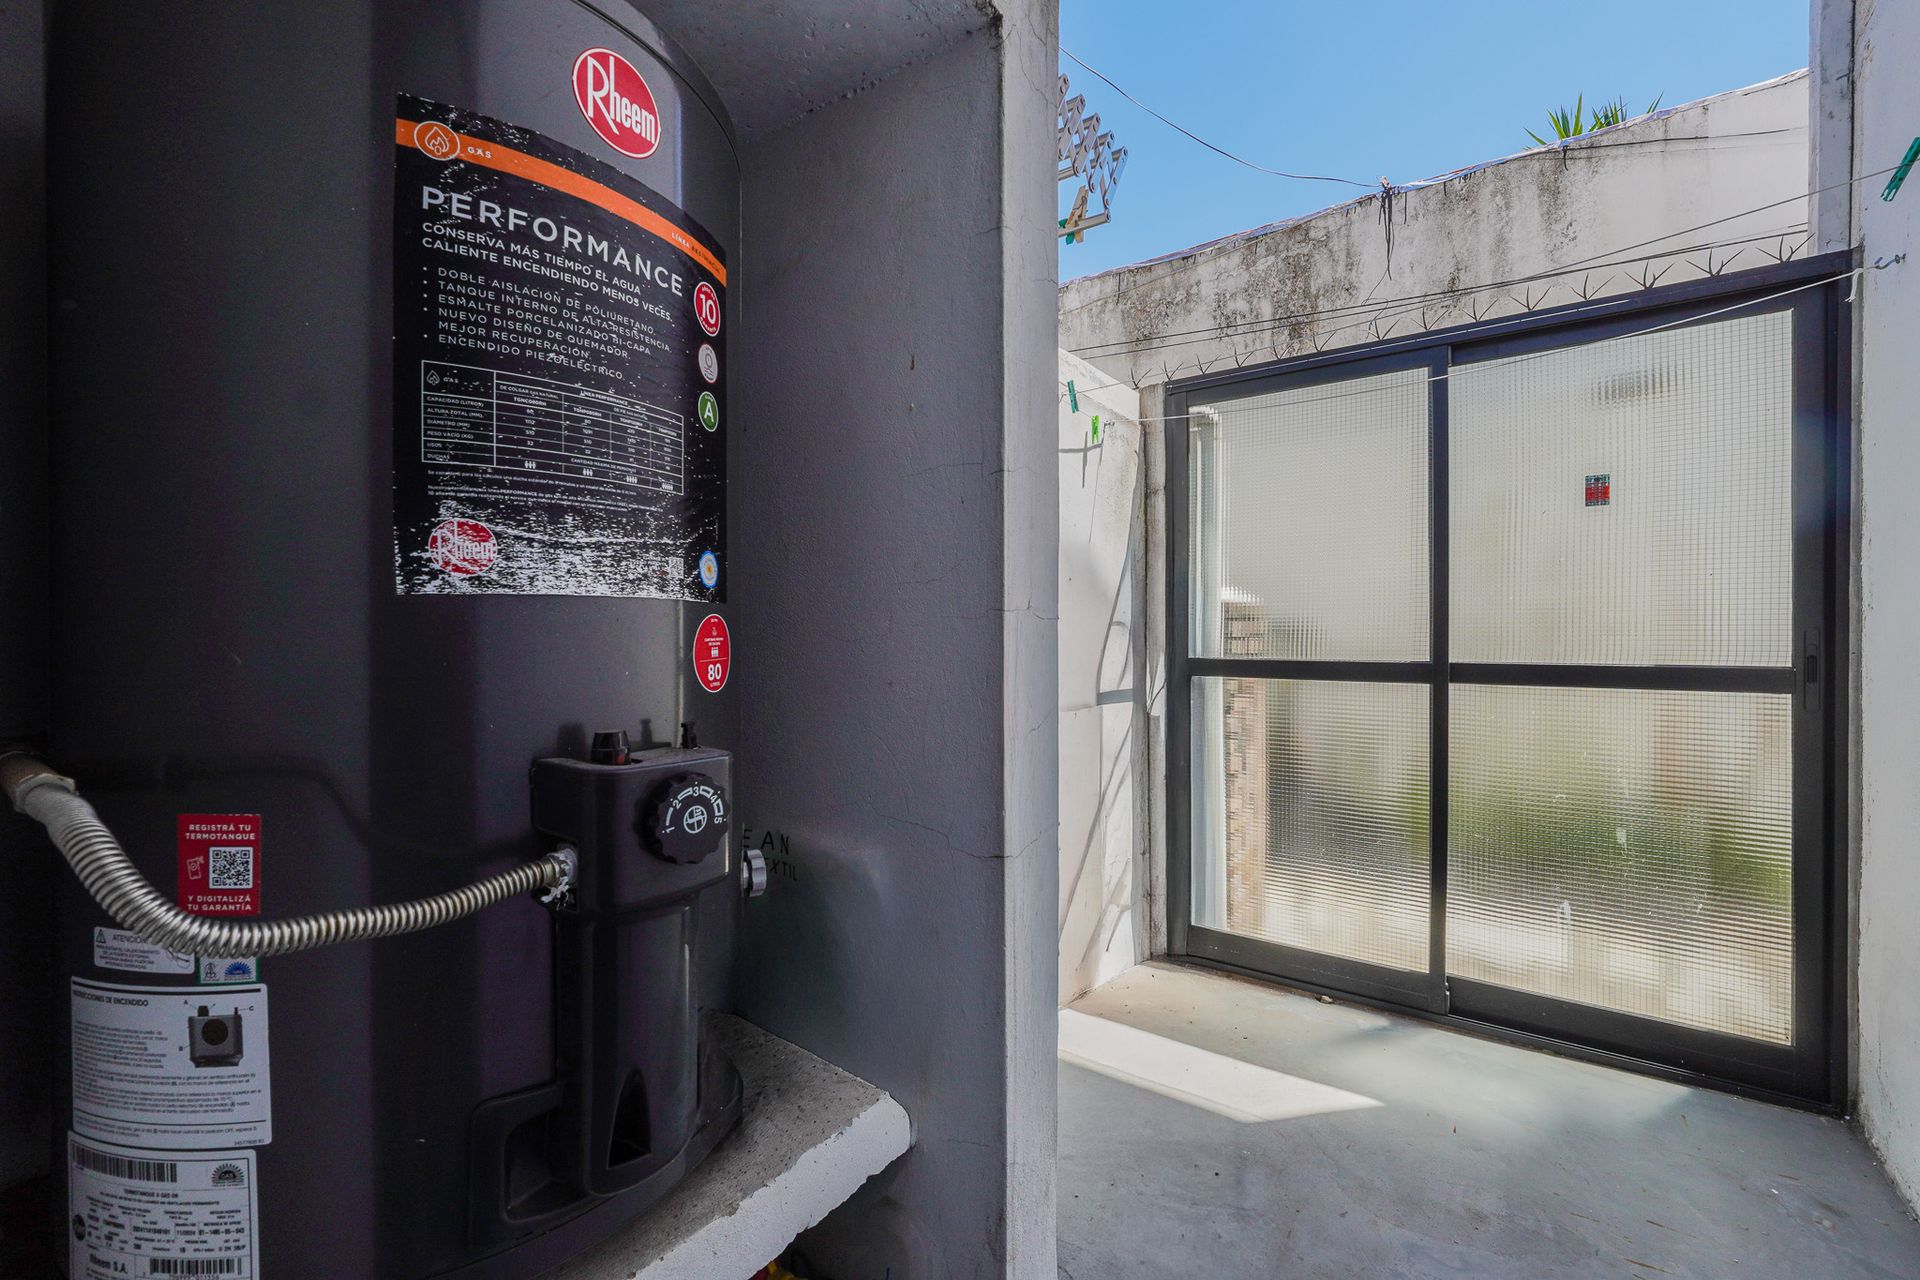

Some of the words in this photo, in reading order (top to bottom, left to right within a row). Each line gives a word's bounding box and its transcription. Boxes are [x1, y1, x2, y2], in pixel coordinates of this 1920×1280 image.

[587, 56, 655, 145] Rheem
[467, 146, 492, 159] GAS
[422, 185, 683, 297] PERFORMANCE
[422, 222, 505, 250] CONSERVA
[510, 243, 540, 259] MÁS
[544, 253, 592, 276] TIEMPO
[595, 270, 609, 282] EL
[612, 276, 641, 294] AGUA
[422, 237, 498, 263] CALIENTE
[504, 256, 598, 291] ENCENDIENDO
[602, 286, 640, 307] MENOS
[438, 268, 486, 285] DOBLE
[492, 280, 560, 304] AISLACIÓN
[566, 298, 581, 310] DE
[438, 281, 496, 300] TANQUE
[502, 294, 558, 315] INTERNO
[562, 310, 578, 320] DE
[582, 315, 609, 330] ALTA
[700, 294, 716, 324] 10
[438, 308, 487, 324] NUEVO
[493, 318, 542, 335] DISEÑO
[547, 330, 562, 340] DE
[438, 294, 501, 314] ESMALTE
[507, 308, 608, 341] PORCELANIZADO
[612, 335, 651, 355] BI-CAPA
[438, 321, 486, 337] MEJOR
[438, 334, 520, 356] ENCENDIDO
[704, 401, 714, 422] A
[708, 664, 722, 681] 80
[672, 800, 682, 810] 2
[693, 786, 699, 796] 3
[710, 794, 718, 804] 4
[188, 823, 236, 832] REGISTRÁ
[197, 894, 250, 902] DIGITALIZÁ
[202, 903, 252, 911] GARANTÍA
